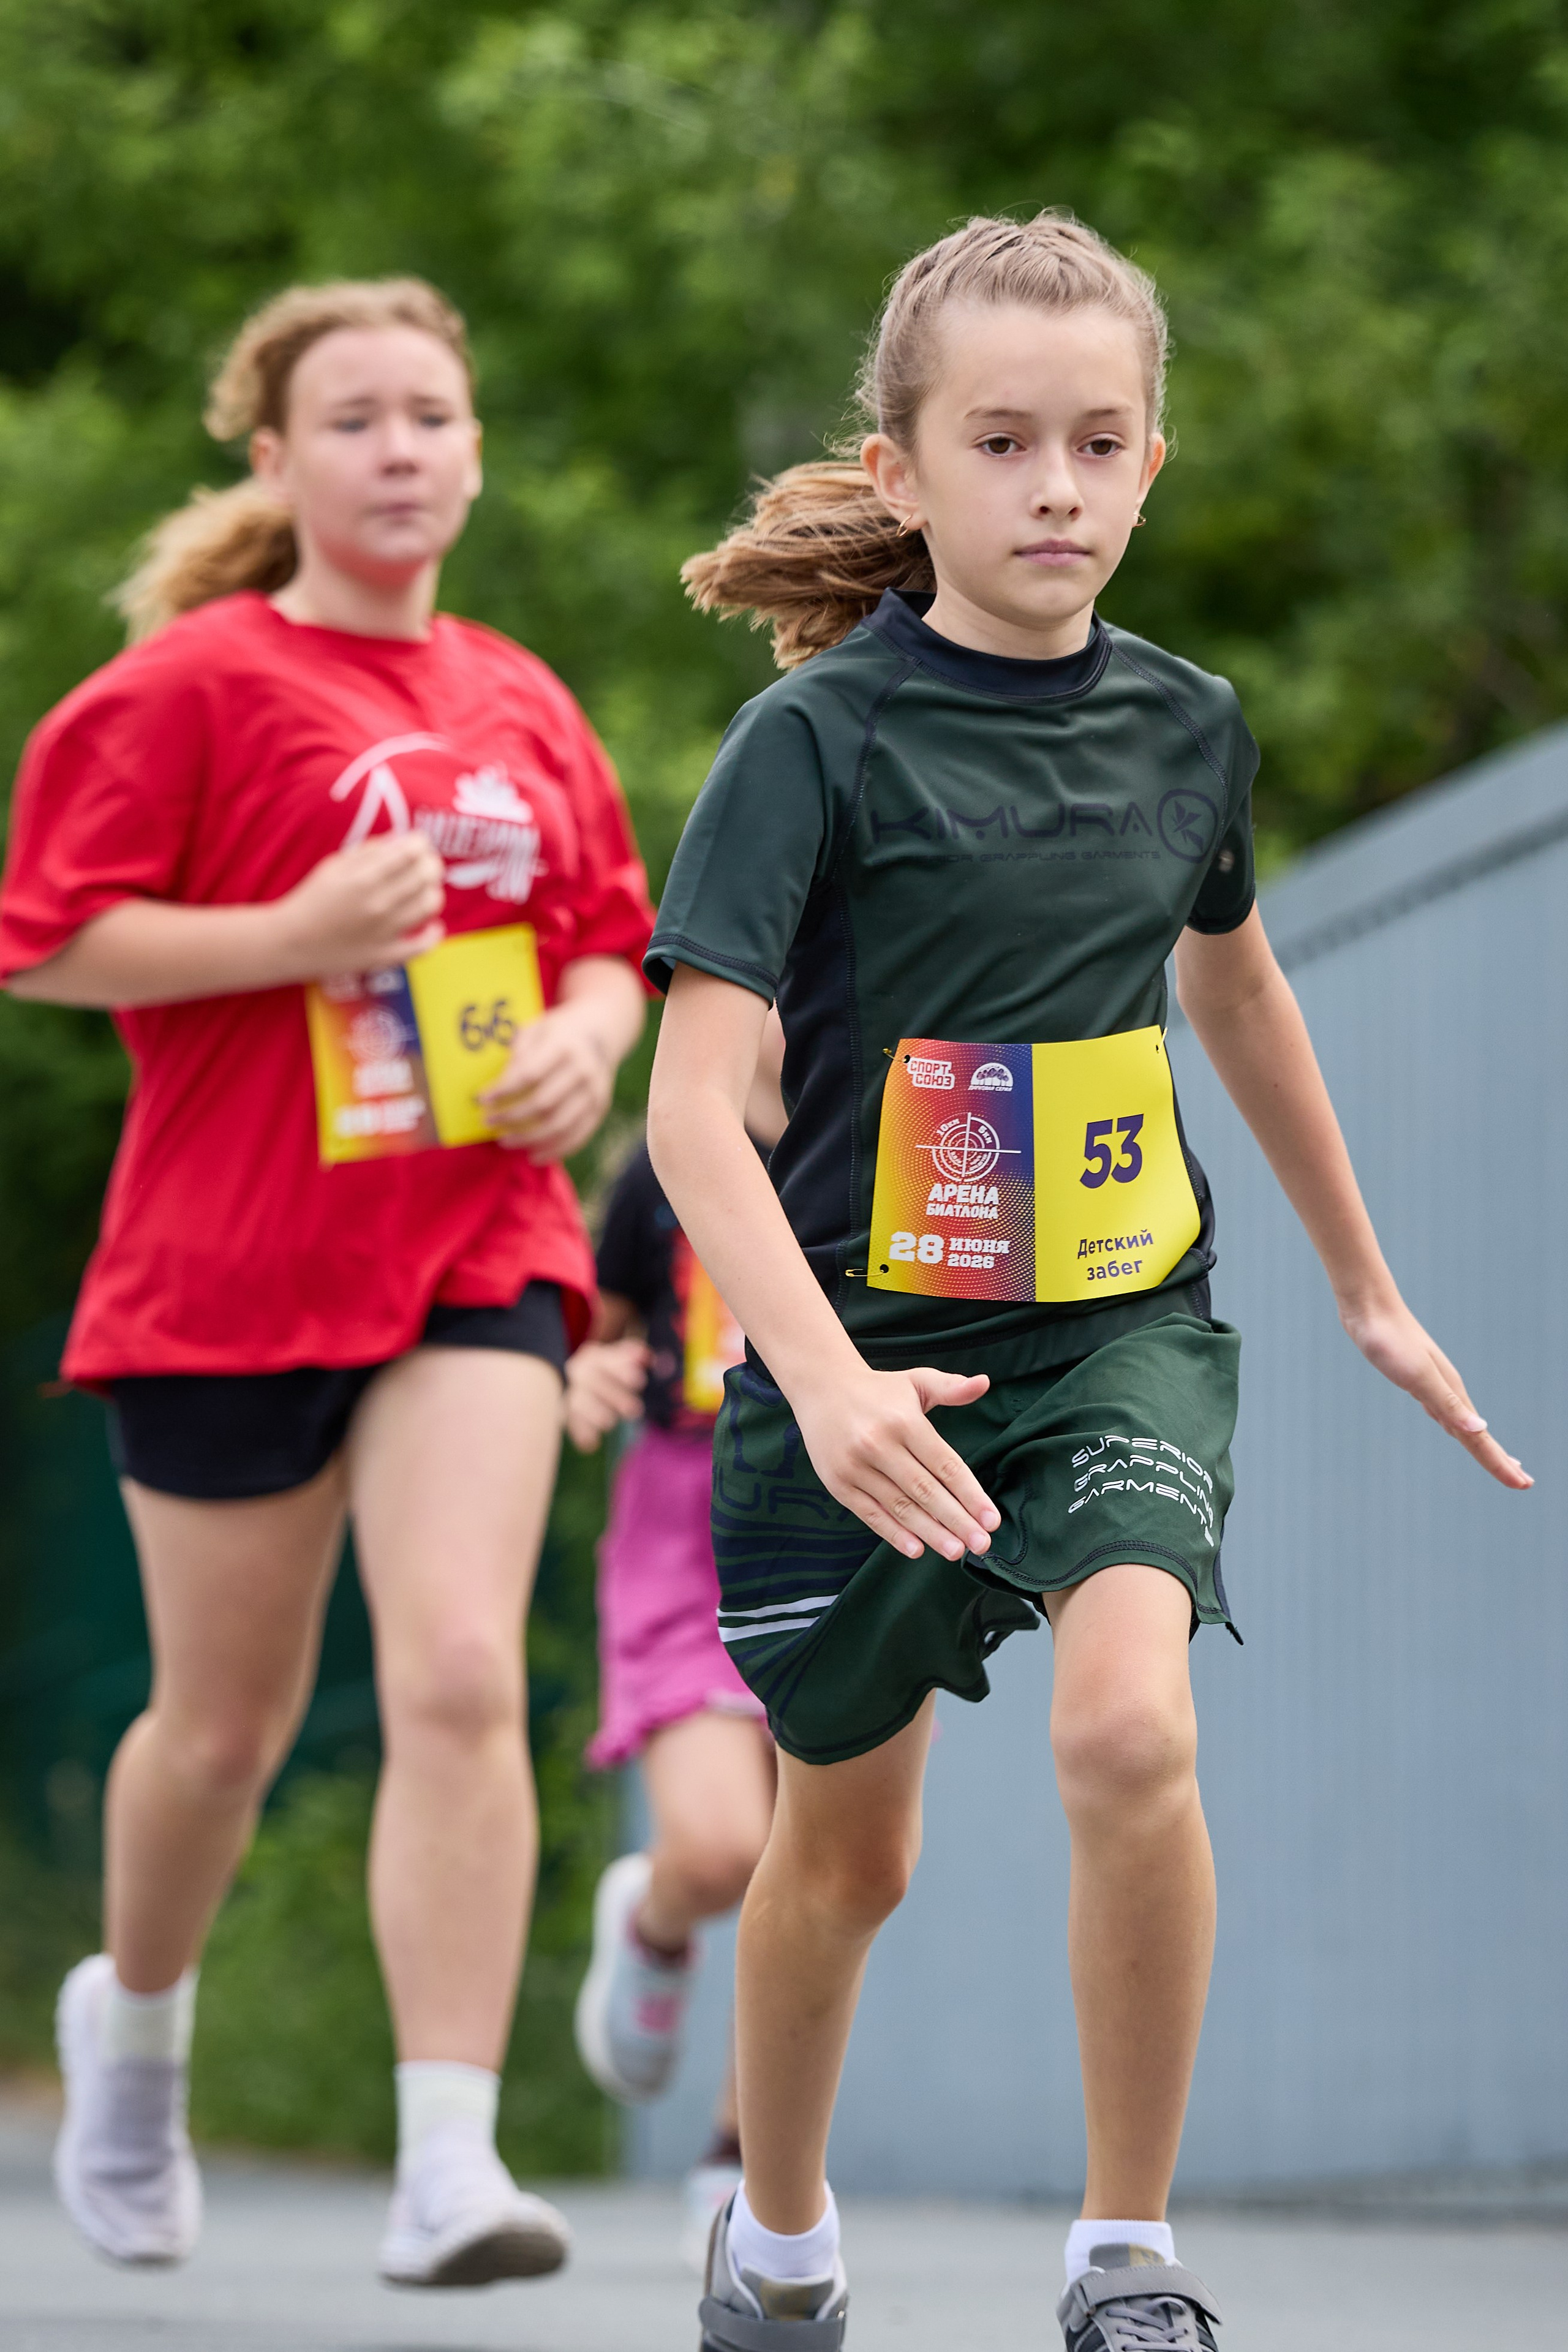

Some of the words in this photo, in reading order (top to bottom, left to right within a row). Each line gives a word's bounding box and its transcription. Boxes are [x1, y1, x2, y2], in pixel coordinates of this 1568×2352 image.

[870, 802, 1153, 844] KIMURA
[910, 1060, 948, 1075] СПОРТ
[915, 1073, 952, 1087] СОЮЗ
[1079, 1113, 1144, 1189] 53
[928, 1183, 1000, 1205] АРЕНА
[925, 1203, 999, 1219] БИАТЛОНА
[889, 1231, 944, 1264] 28
[1077, 1229, 1154, 1260] Детский
[947, 1253, 995, 1269] 2026
[1087, 1260, 1143, 1281] забег
[1072, 1435, 1213, 1494] SUPERIOR
[1074, 1454, 1214, 1529] GRAPPLING
